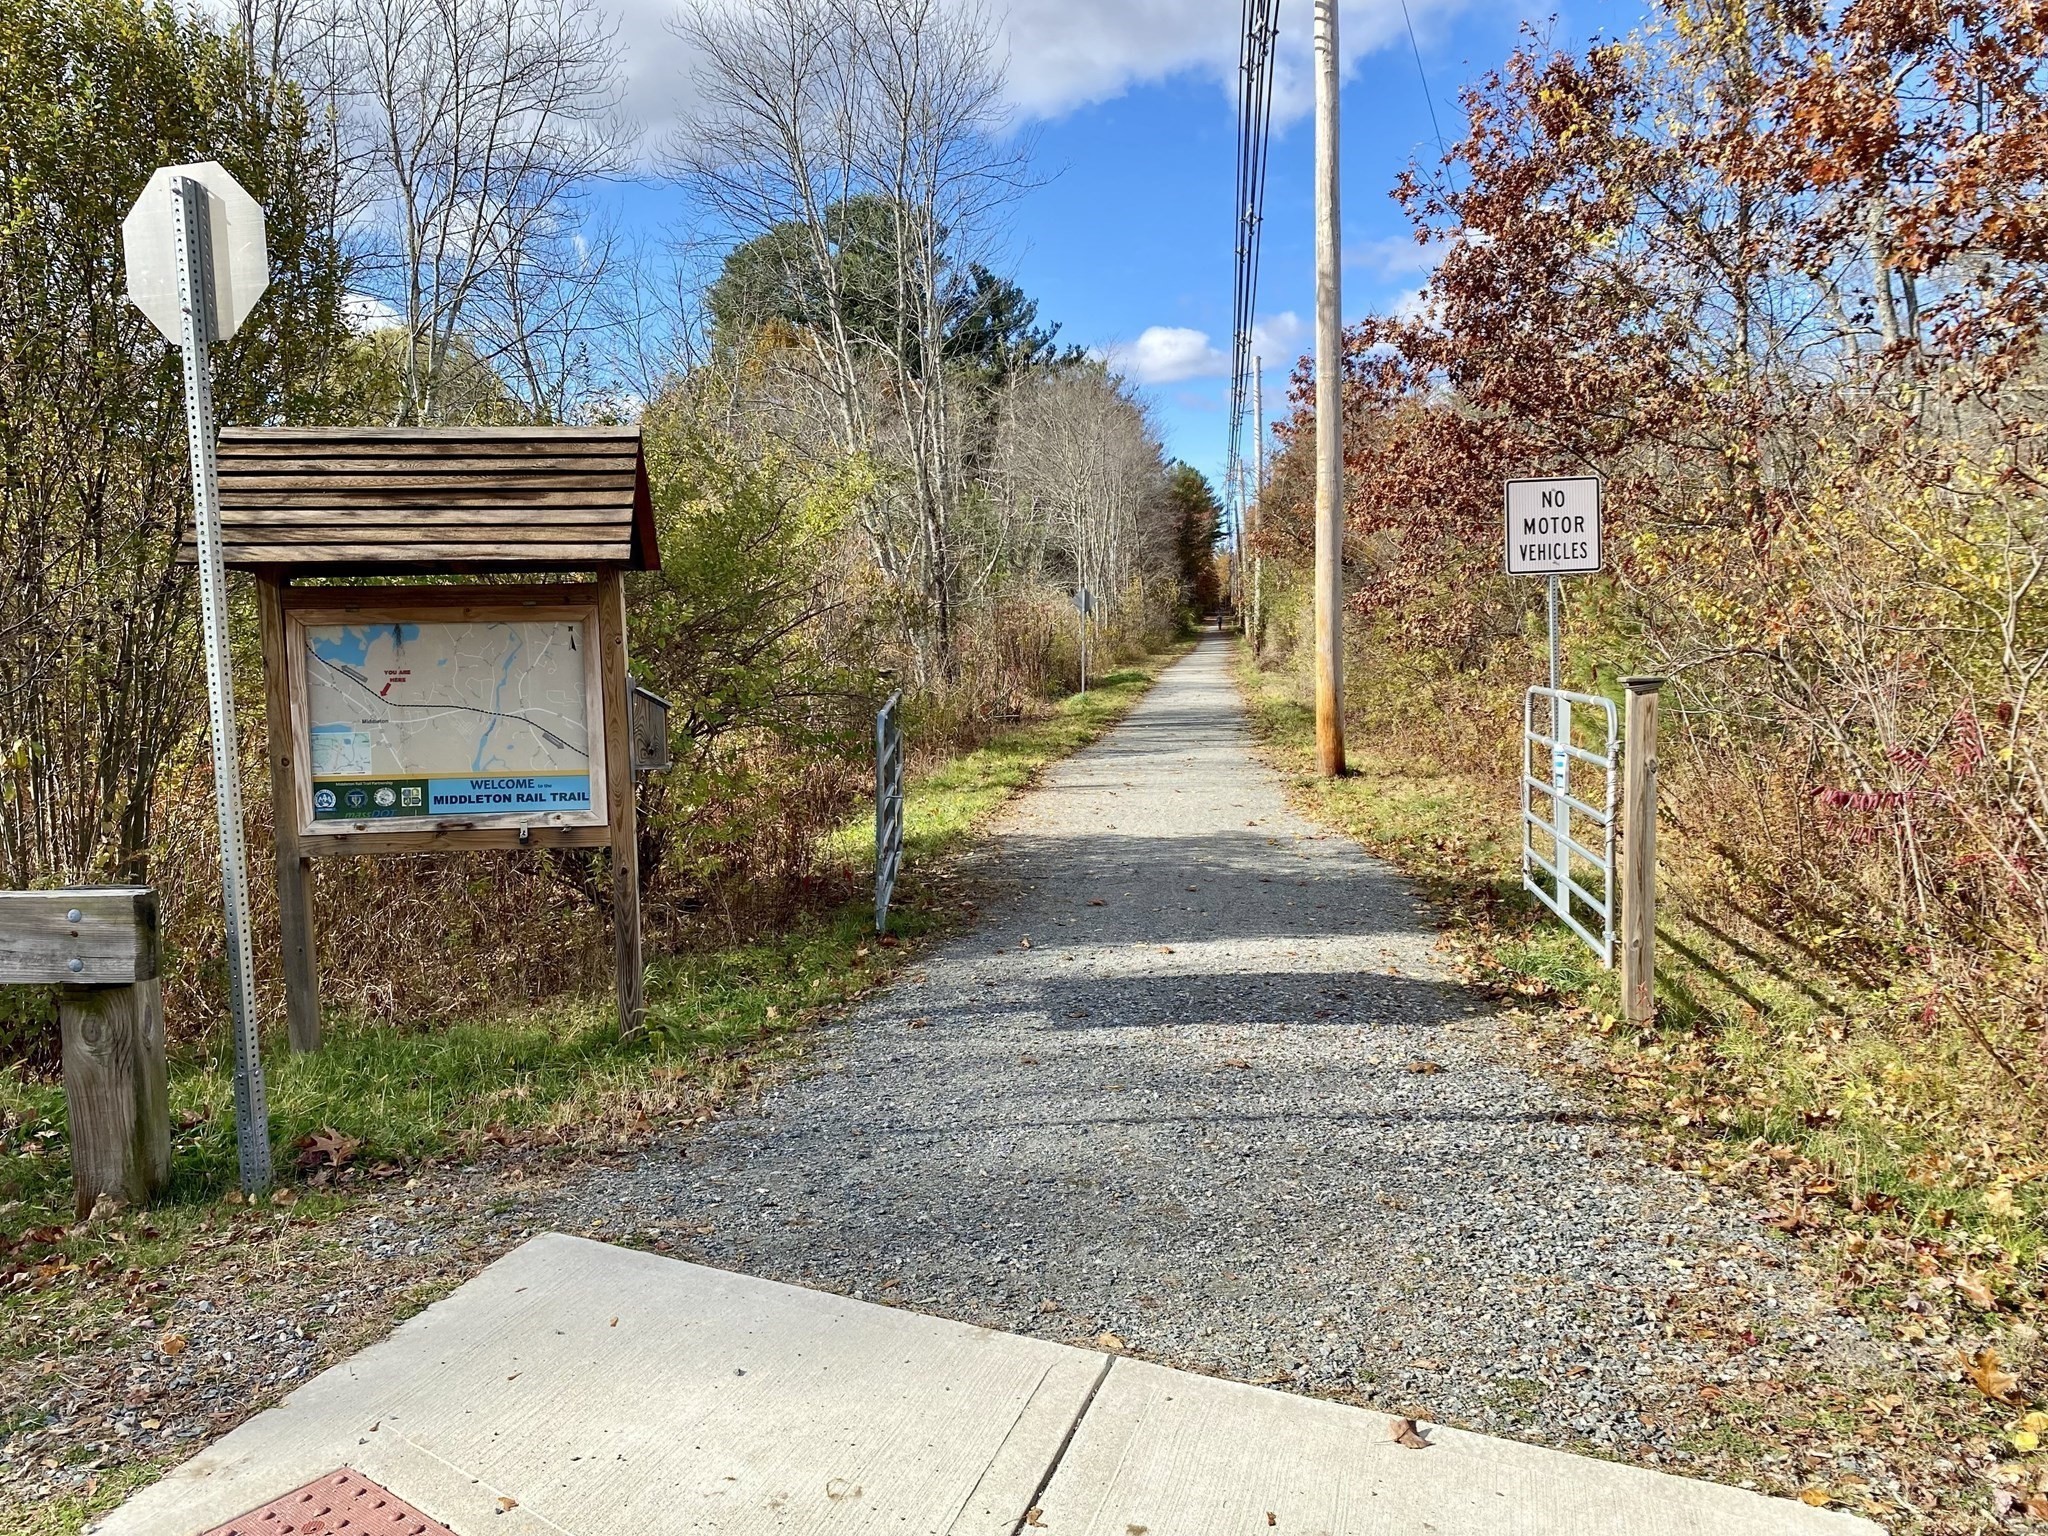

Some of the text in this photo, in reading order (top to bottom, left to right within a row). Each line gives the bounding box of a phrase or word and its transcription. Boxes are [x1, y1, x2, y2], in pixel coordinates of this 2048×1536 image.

[1542, 490, 1565, 508] NO
[1524, 516, 1584, 535] MOTOR
[1520, 542, 1588, 561] VEHICLES
[470, 779, 534, 790] WELCOME
[433, 794, 512, 804] MIDDLETON
[516, 792, 547, 803] RAIL
[550, 792, 590, 802] TRAIL
